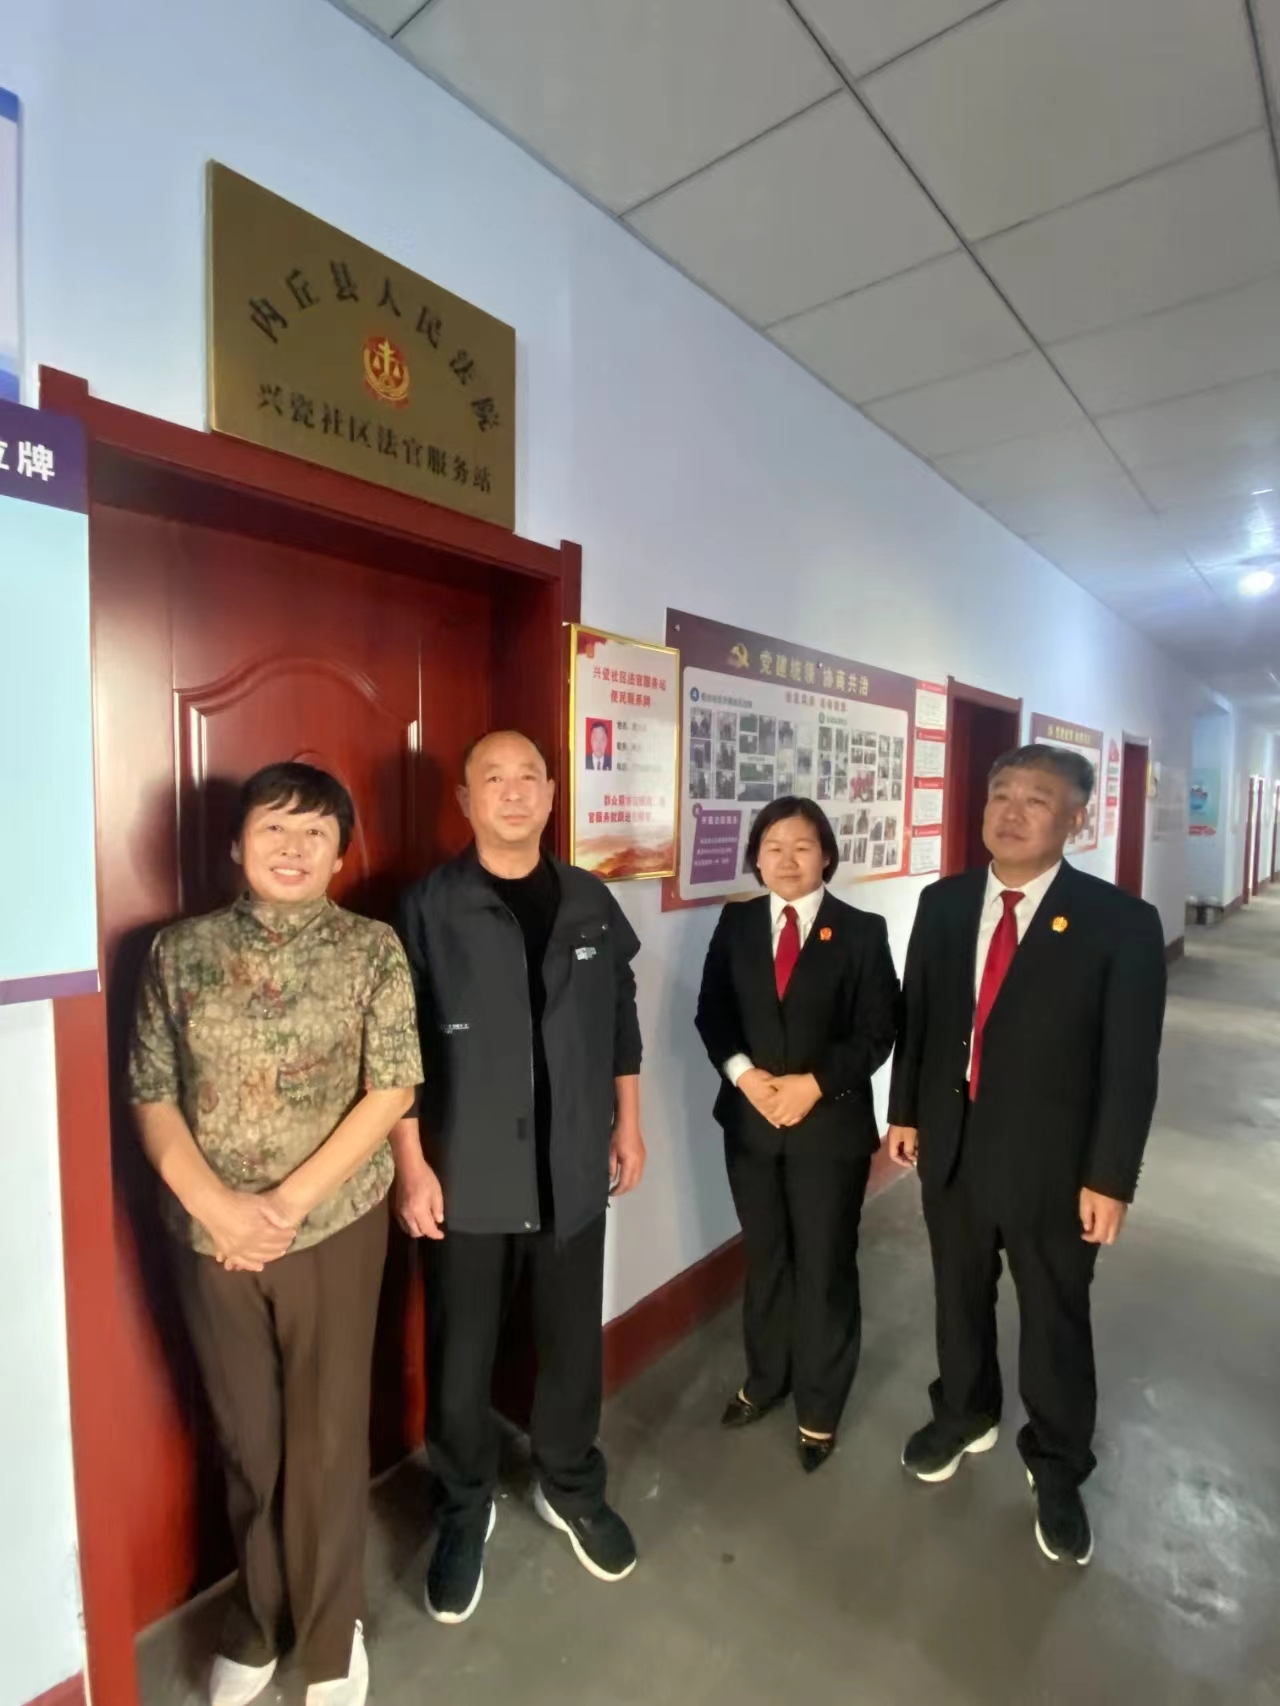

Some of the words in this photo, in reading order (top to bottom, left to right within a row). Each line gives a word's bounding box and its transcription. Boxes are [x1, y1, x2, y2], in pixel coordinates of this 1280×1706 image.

[249, 259, 500, 434] 内丘县人民法院
[0, 441, 55, 481] 牌
[257, 383, 493, 494] 兴瓷社区法官服务站
